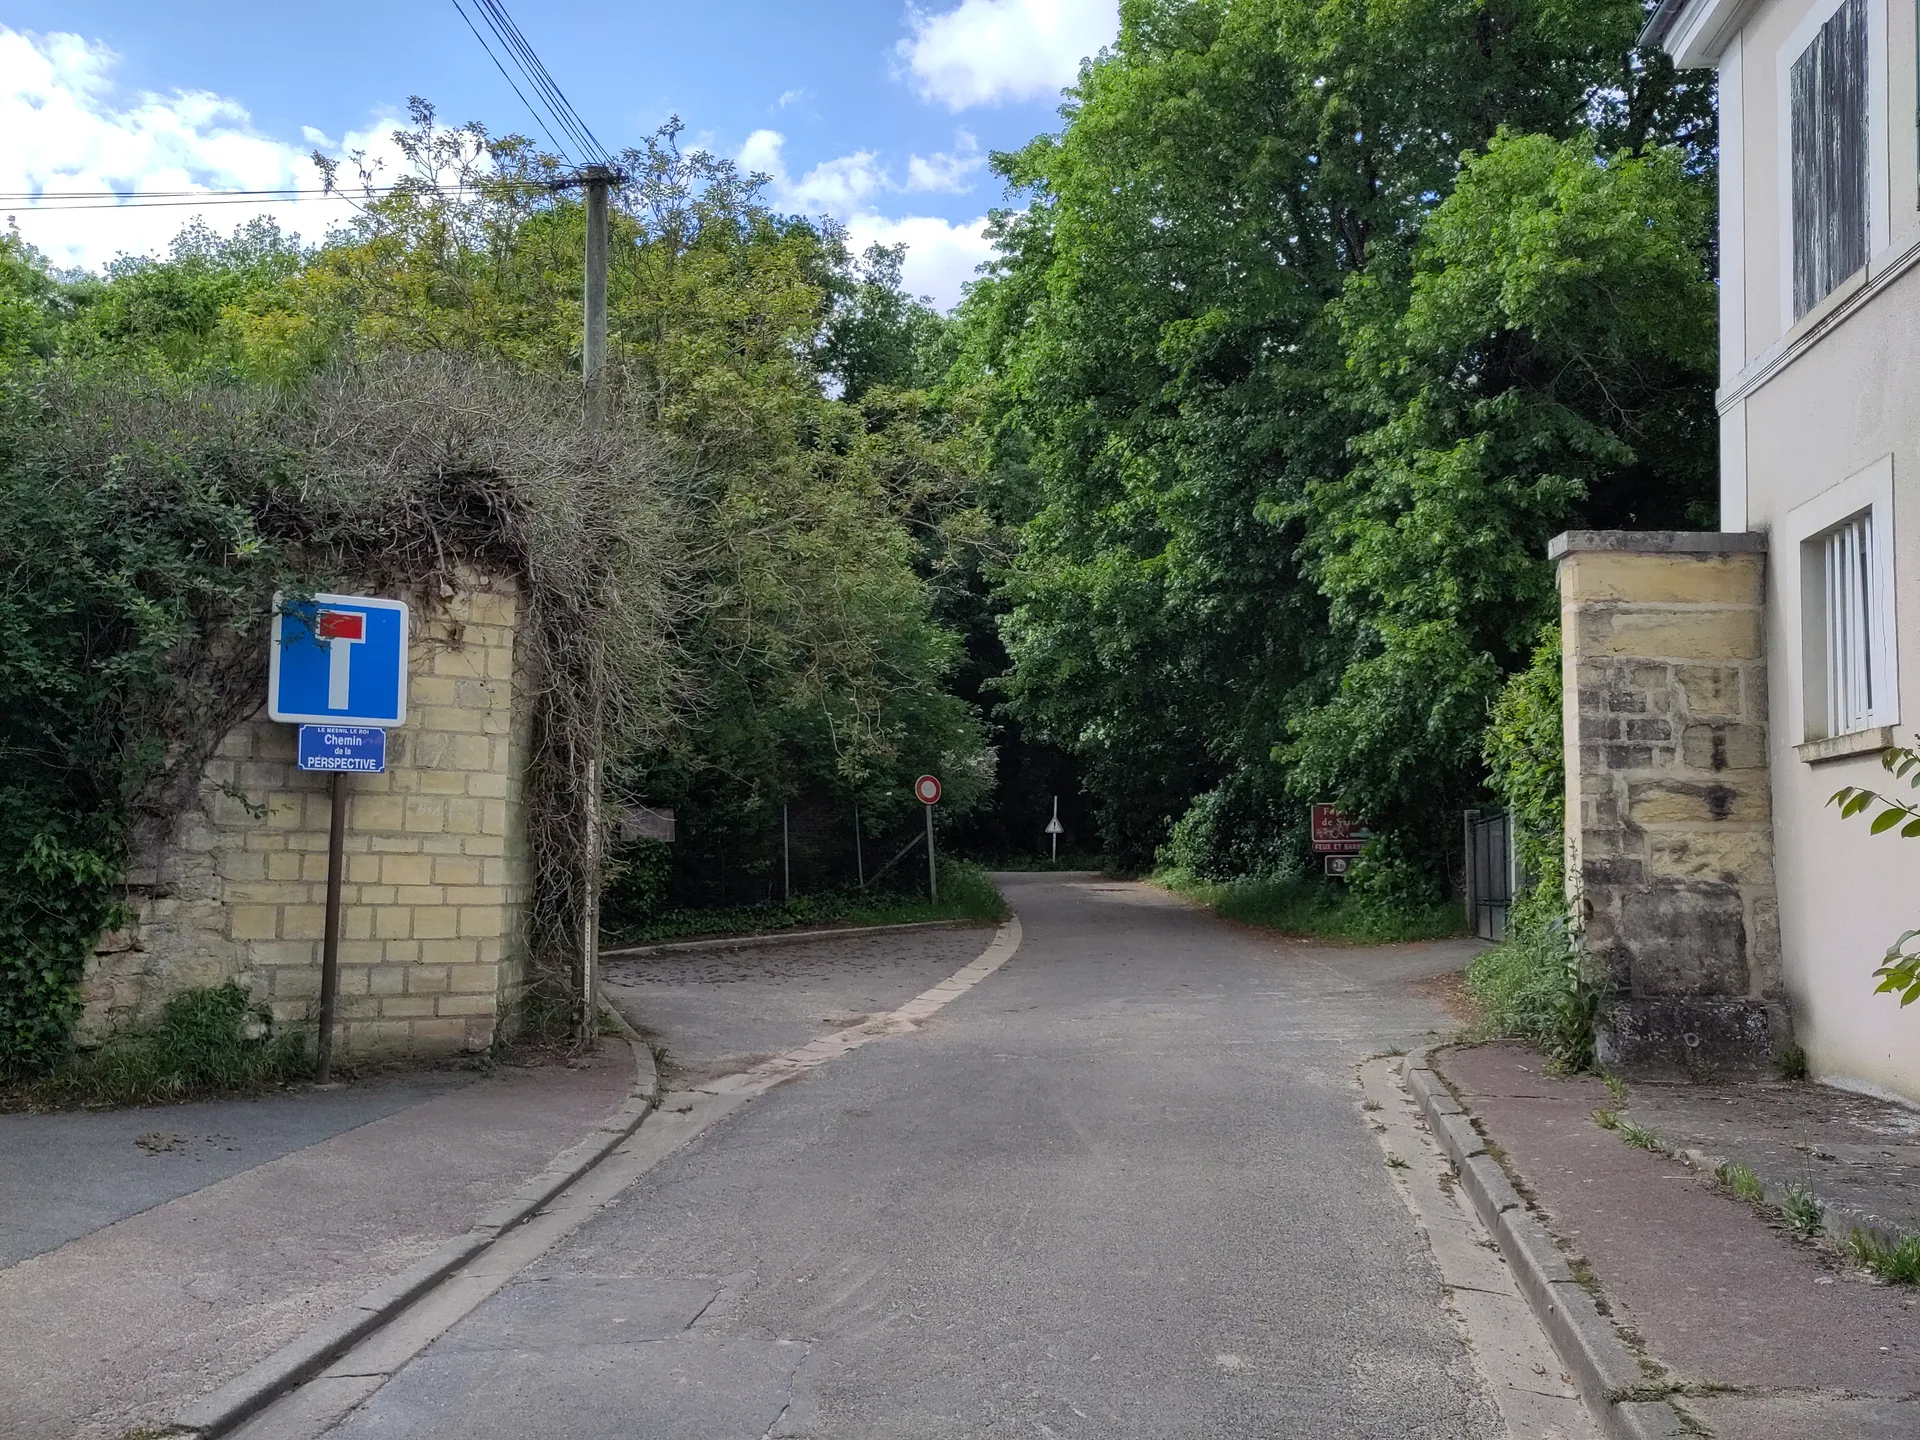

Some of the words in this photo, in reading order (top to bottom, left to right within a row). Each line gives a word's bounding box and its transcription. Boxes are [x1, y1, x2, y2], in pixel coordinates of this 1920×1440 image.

[324, 734, 362, 746] Chemin
[308, 757, 376, 769] PERSPECTIVE
[1321, 818, 1333, 826] de
